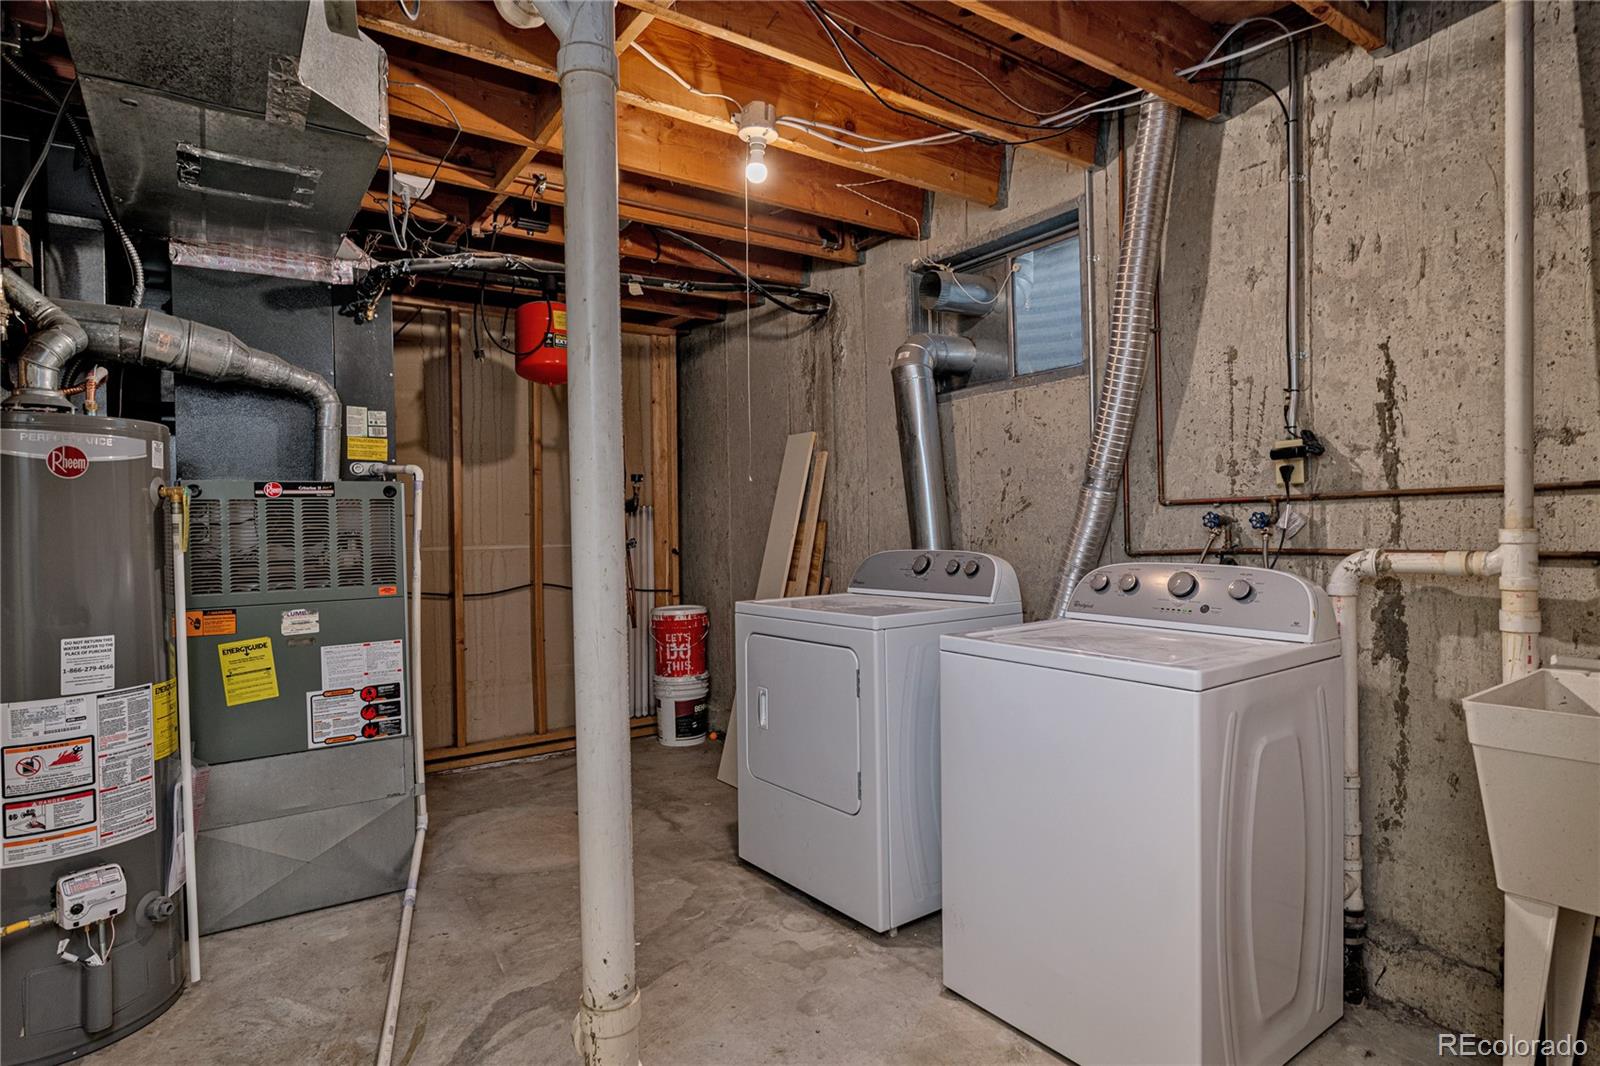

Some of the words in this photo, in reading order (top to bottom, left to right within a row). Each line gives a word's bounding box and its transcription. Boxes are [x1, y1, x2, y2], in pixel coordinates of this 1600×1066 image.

[51, 446, 86, 473] Rheem
[665, 632, 691, 643] LET'S
[665, 643, 691, 660] DO
